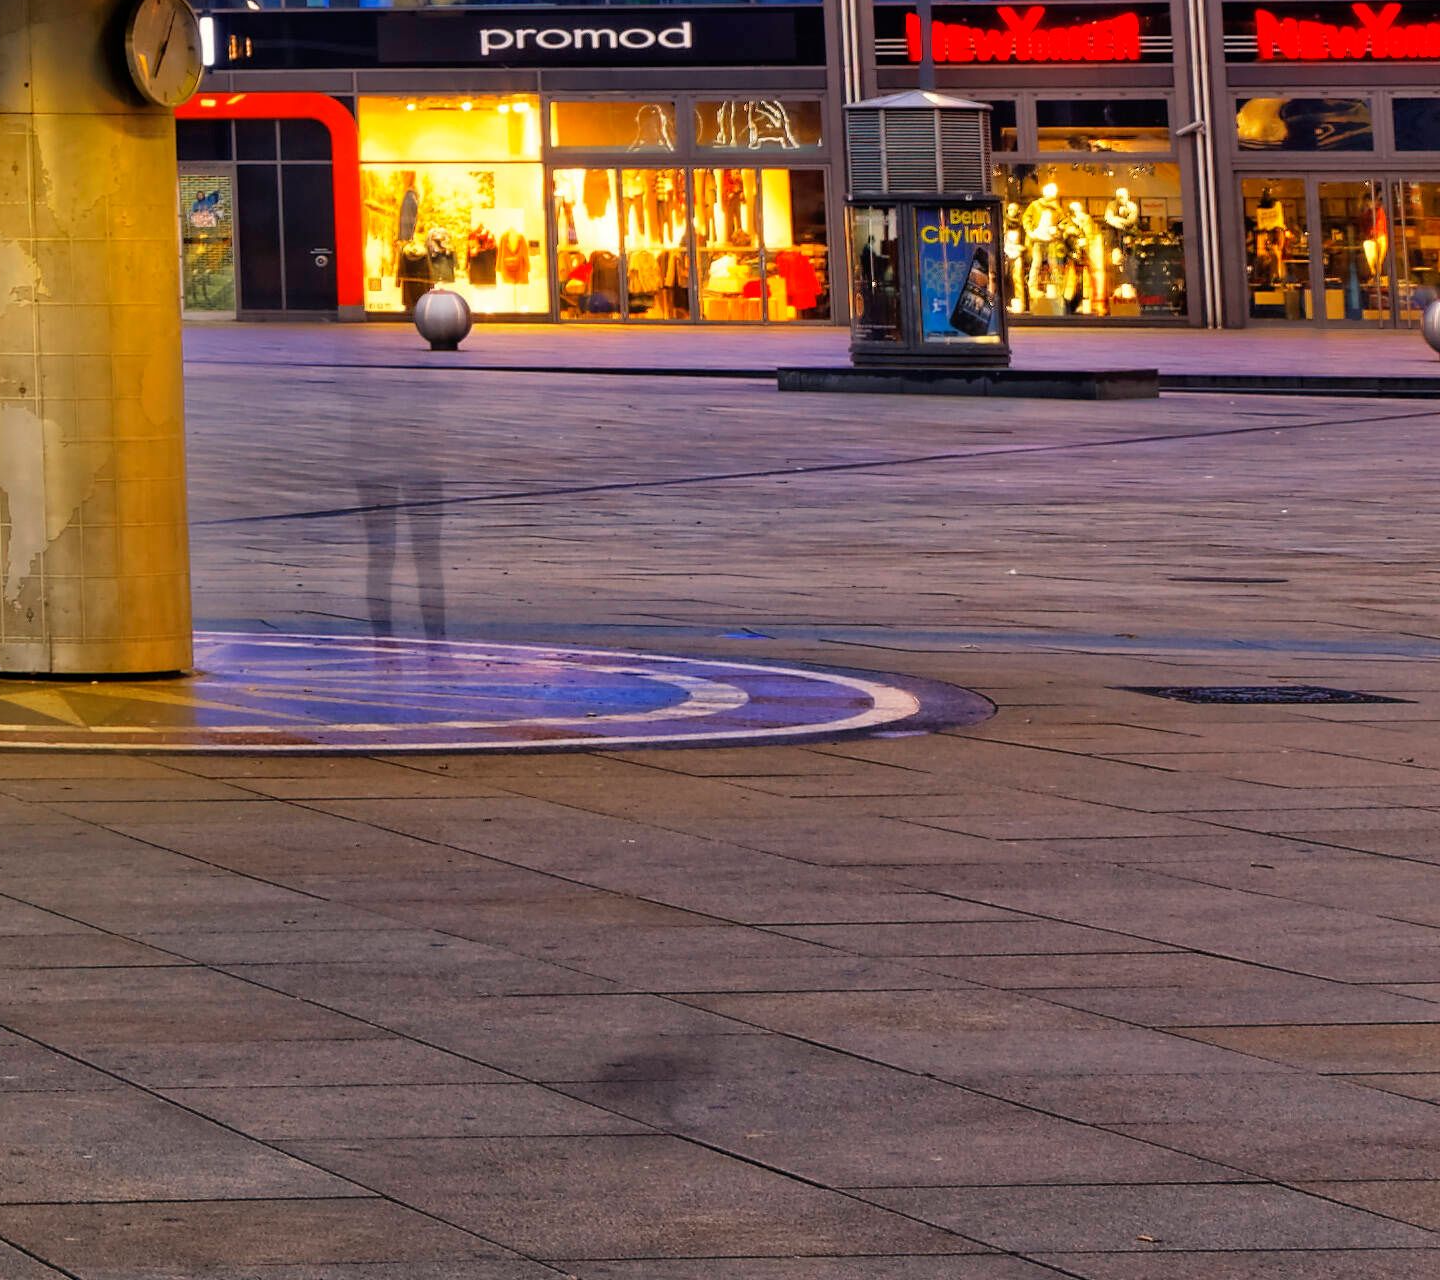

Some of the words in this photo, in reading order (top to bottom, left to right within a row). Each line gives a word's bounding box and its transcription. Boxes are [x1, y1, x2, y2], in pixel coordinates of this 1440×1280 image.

[480, 21, 693, 56] promod
[950, 208, 992, 225] Berlin
[920, 226, 962, 247] City
[965, 226, 993, 244] Info
